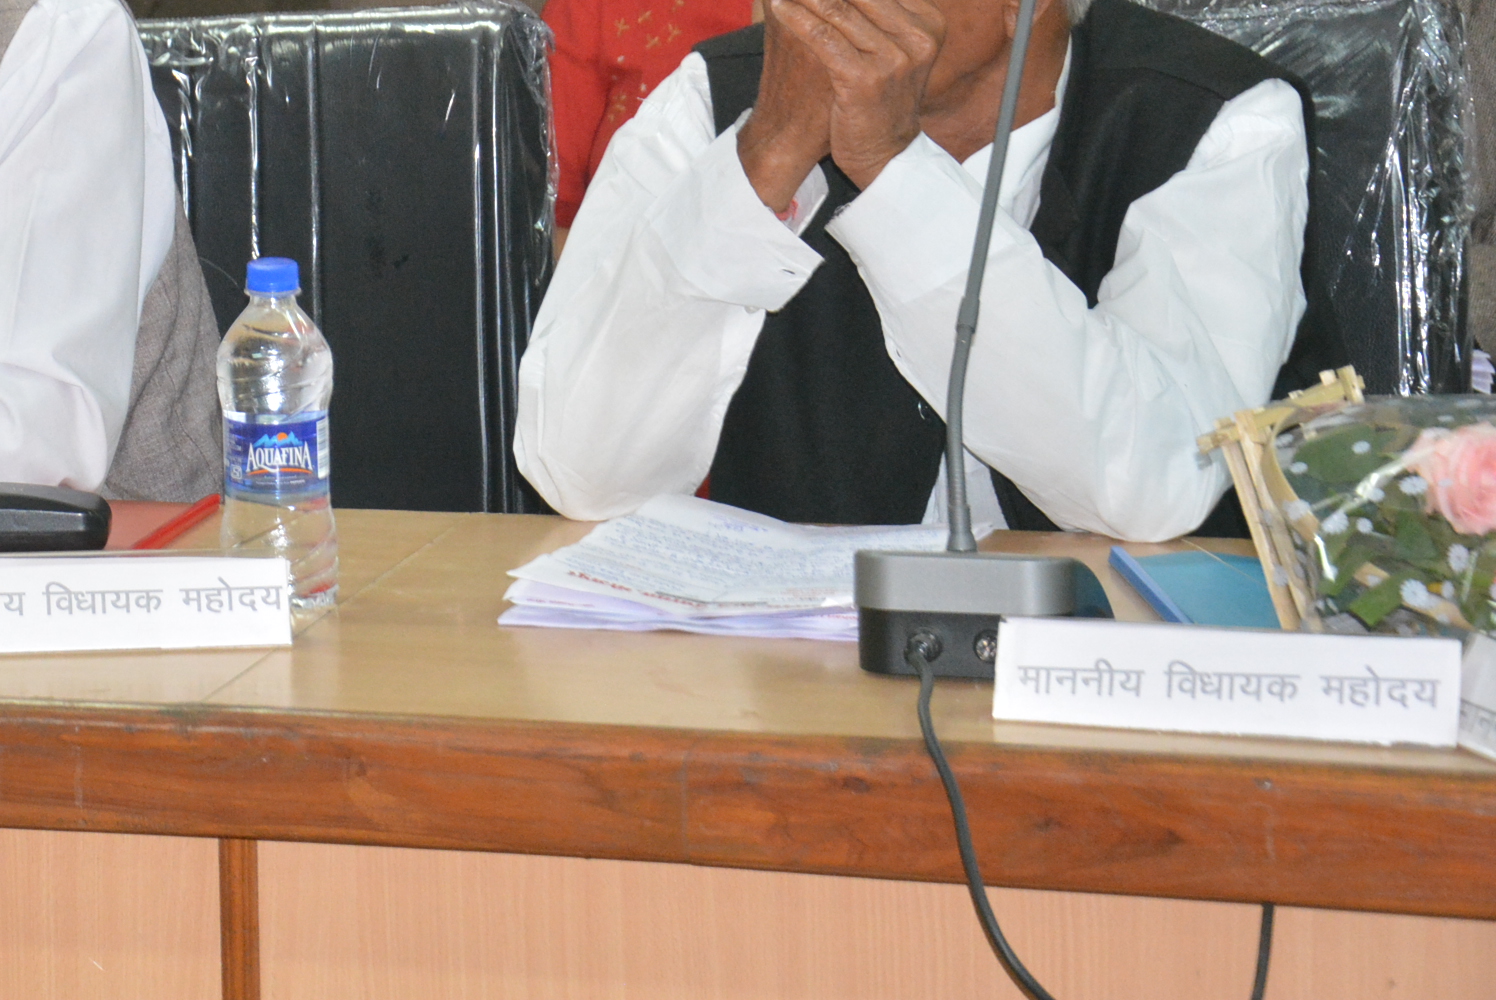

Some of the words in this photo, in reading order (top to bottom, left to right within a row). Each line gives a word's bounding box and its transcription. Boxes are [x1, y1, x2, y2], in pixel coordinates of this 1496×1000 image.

[246, 440, 313, 474] AQUAFINA
[42, 581, 164, 617] विधायक
[179, 576, 284, 615] महोदय
[1017, 658, 1146, 699] माननीय
[1164, 660, 1301, 703] विधायक
[1319, 665, 1441, 708] महोदय
